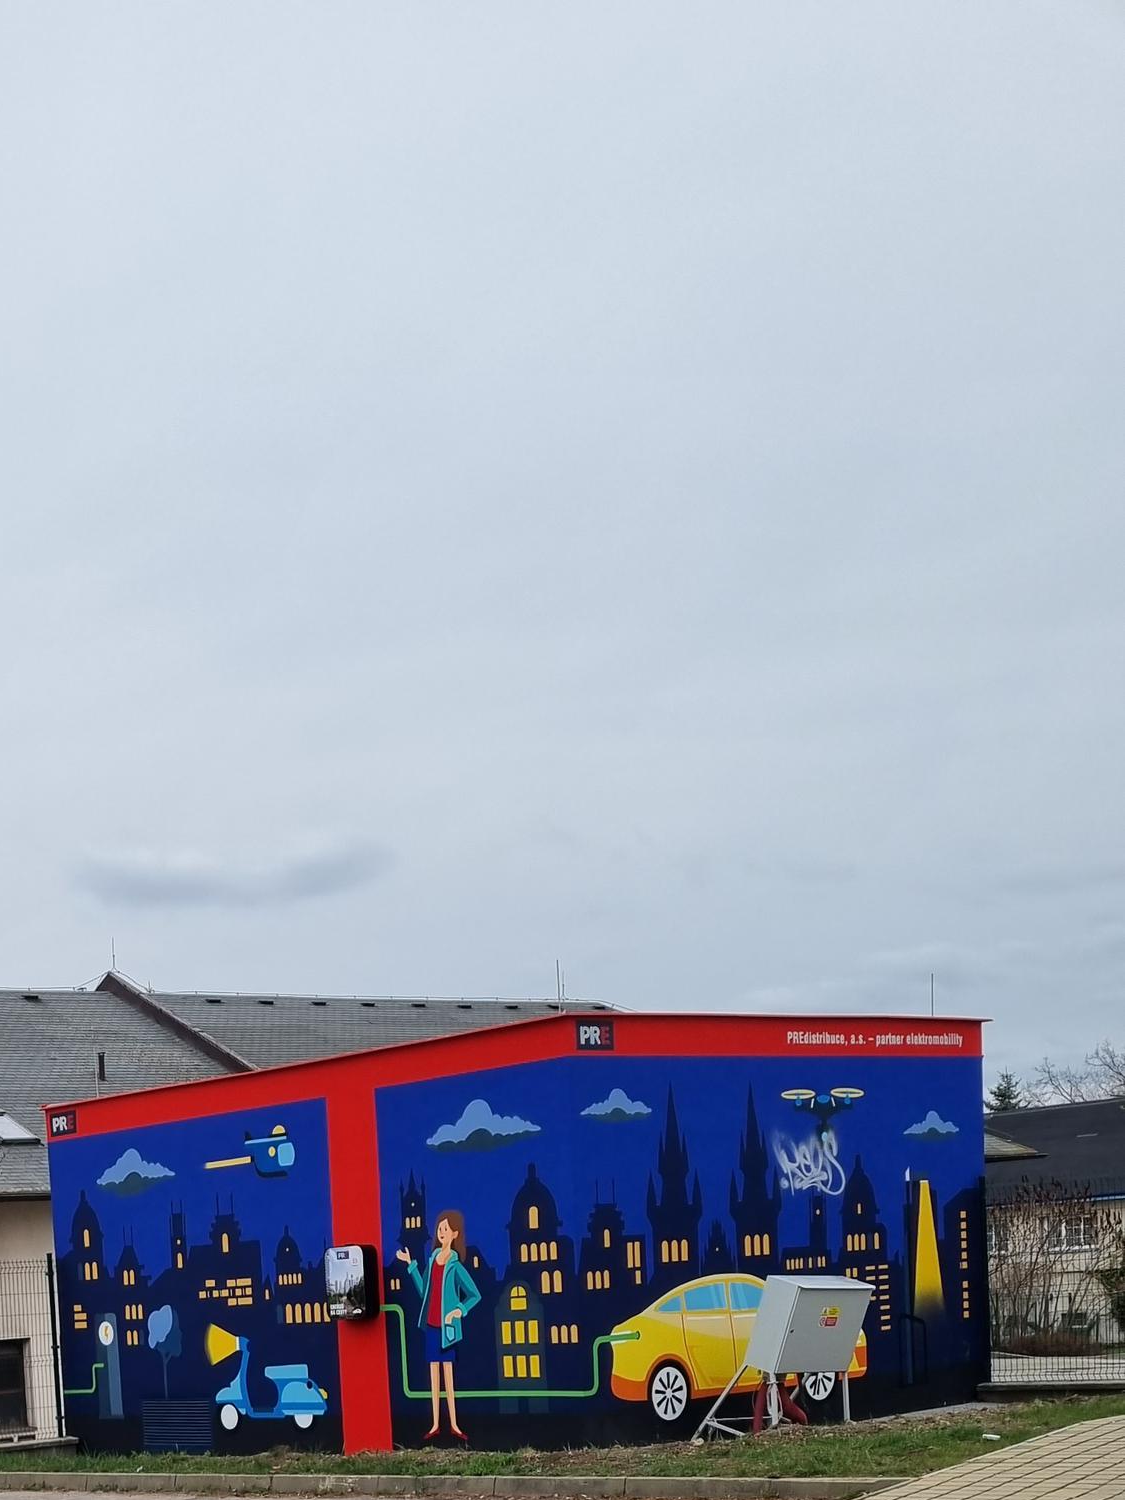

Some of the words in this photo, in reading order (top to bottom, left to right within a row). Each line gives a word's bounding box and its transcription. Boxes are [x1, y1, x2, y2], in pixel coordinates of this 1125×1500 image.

[579, 1025, 611, 1045] PRE
[787, 1031, 848, 1046] PREdistribuce,
[850, 1034, 866, 1045] a.s.
[876, 1032, 904, 1047] partner
[906, 1032, 963, 1047] elektromobility
[52, 1115, 75, 1132] PRE
